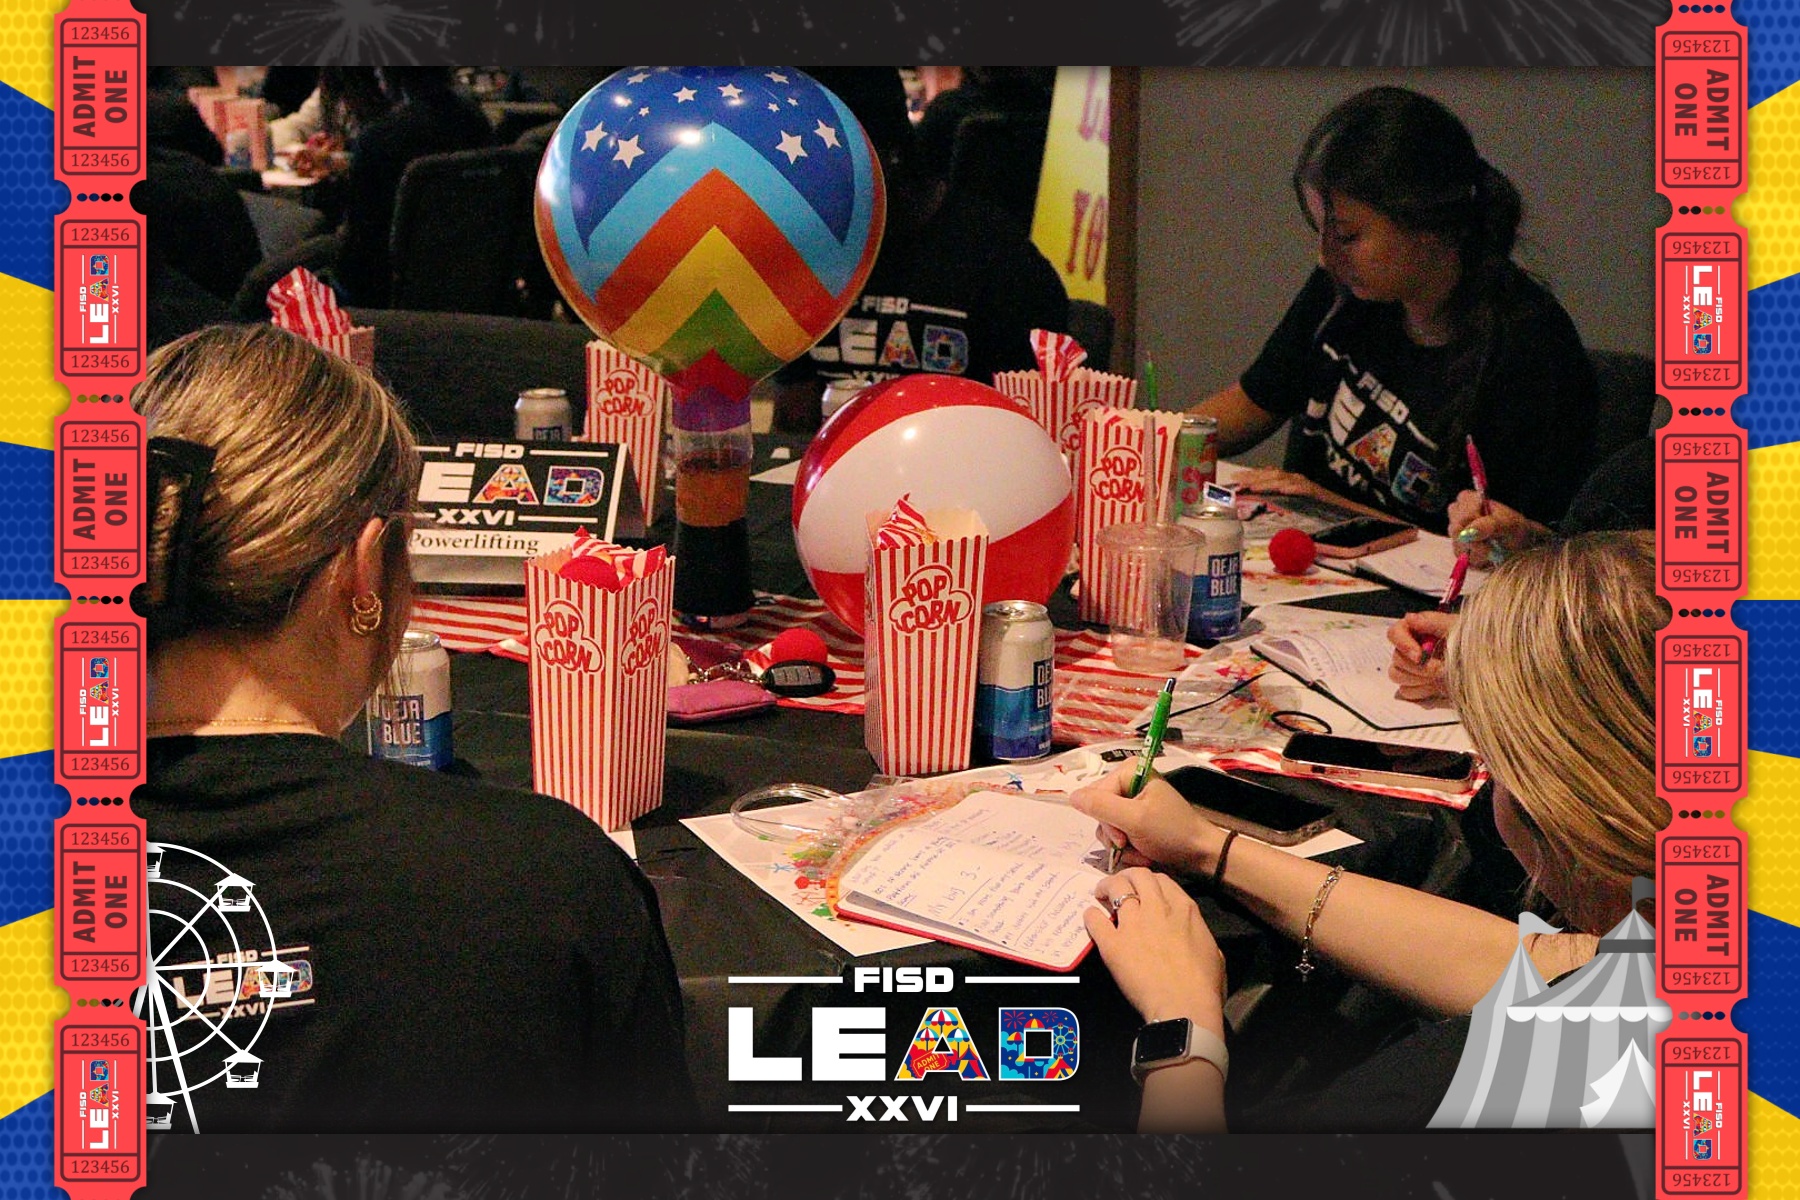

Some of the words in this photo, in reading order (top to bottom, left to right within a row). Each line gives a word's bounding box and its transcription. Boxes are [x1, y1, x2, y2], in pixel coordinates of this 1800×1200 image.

[861, 294, 910, 315] FISD
[604, 377, 636, 396] POP
[1356, 371, 1410, 425] FISD
[600, 397, 647, 417] CORN
[455, 442, 525, 459] FISD
[1101, 456, 1138, 478] POP
[417, 461, 605, 508] EAD
[1097, 478, 1145, 504] CORN
[436, 508, 516, 527] XXVI
[410, 532, 540, 556] Powerlifting
[901, 575, 948, 607] POP
[1209, 575, 1239, 598] BLUE
[543, 611, 580, 640] POP
[629, 608, 656, 646] POP
[899, 600, 962, 634] CORN
[542, 638, 593, 673] CORN
[626, 633, 661, 676] CORN
[383, 721, 421, 745] BLUE
